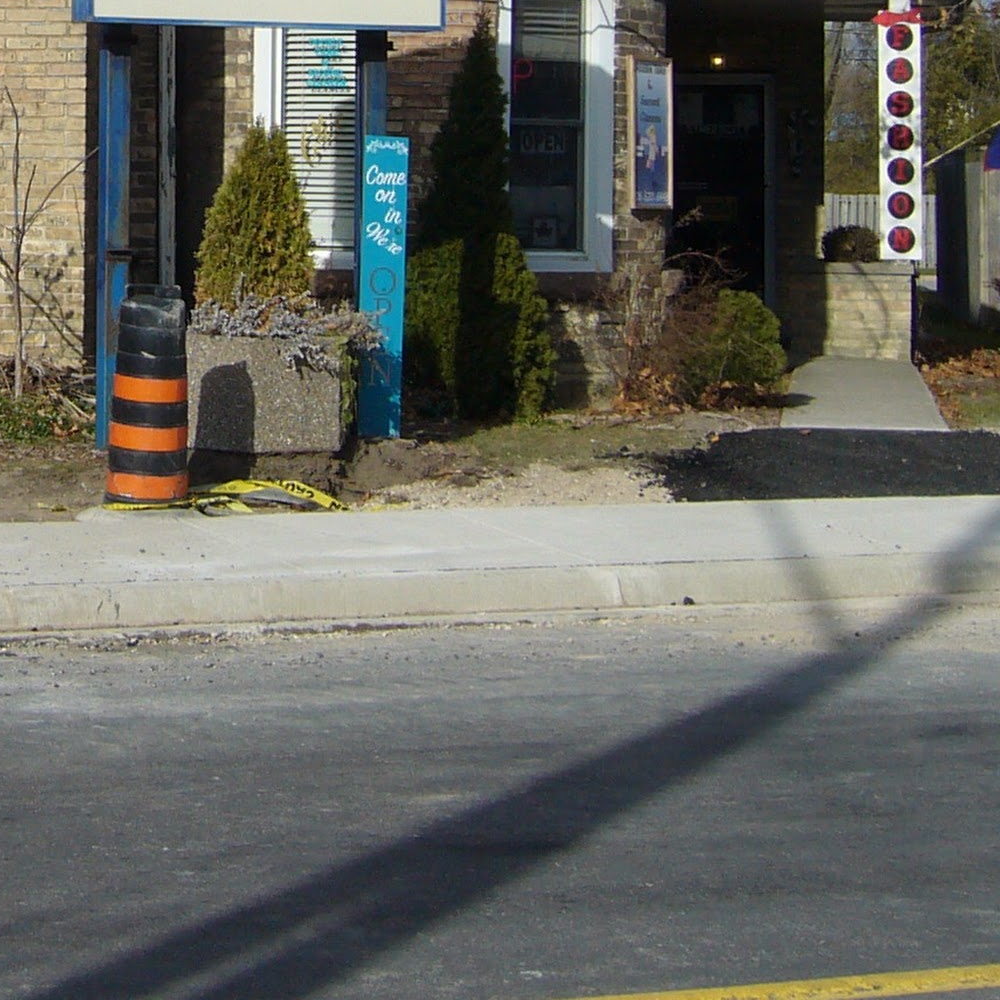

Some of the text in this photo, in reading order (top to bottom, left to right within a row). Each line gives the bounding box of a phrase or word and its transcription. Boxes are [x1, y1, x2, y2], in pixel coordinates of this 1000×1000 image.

[522, 131, 564, 151] OPEN
[890, 26, 913, 250] FASHION
[366, 164, 407, 186] Come
[375, 188, 397, 204] on
[384, 206, 403, 225] in
